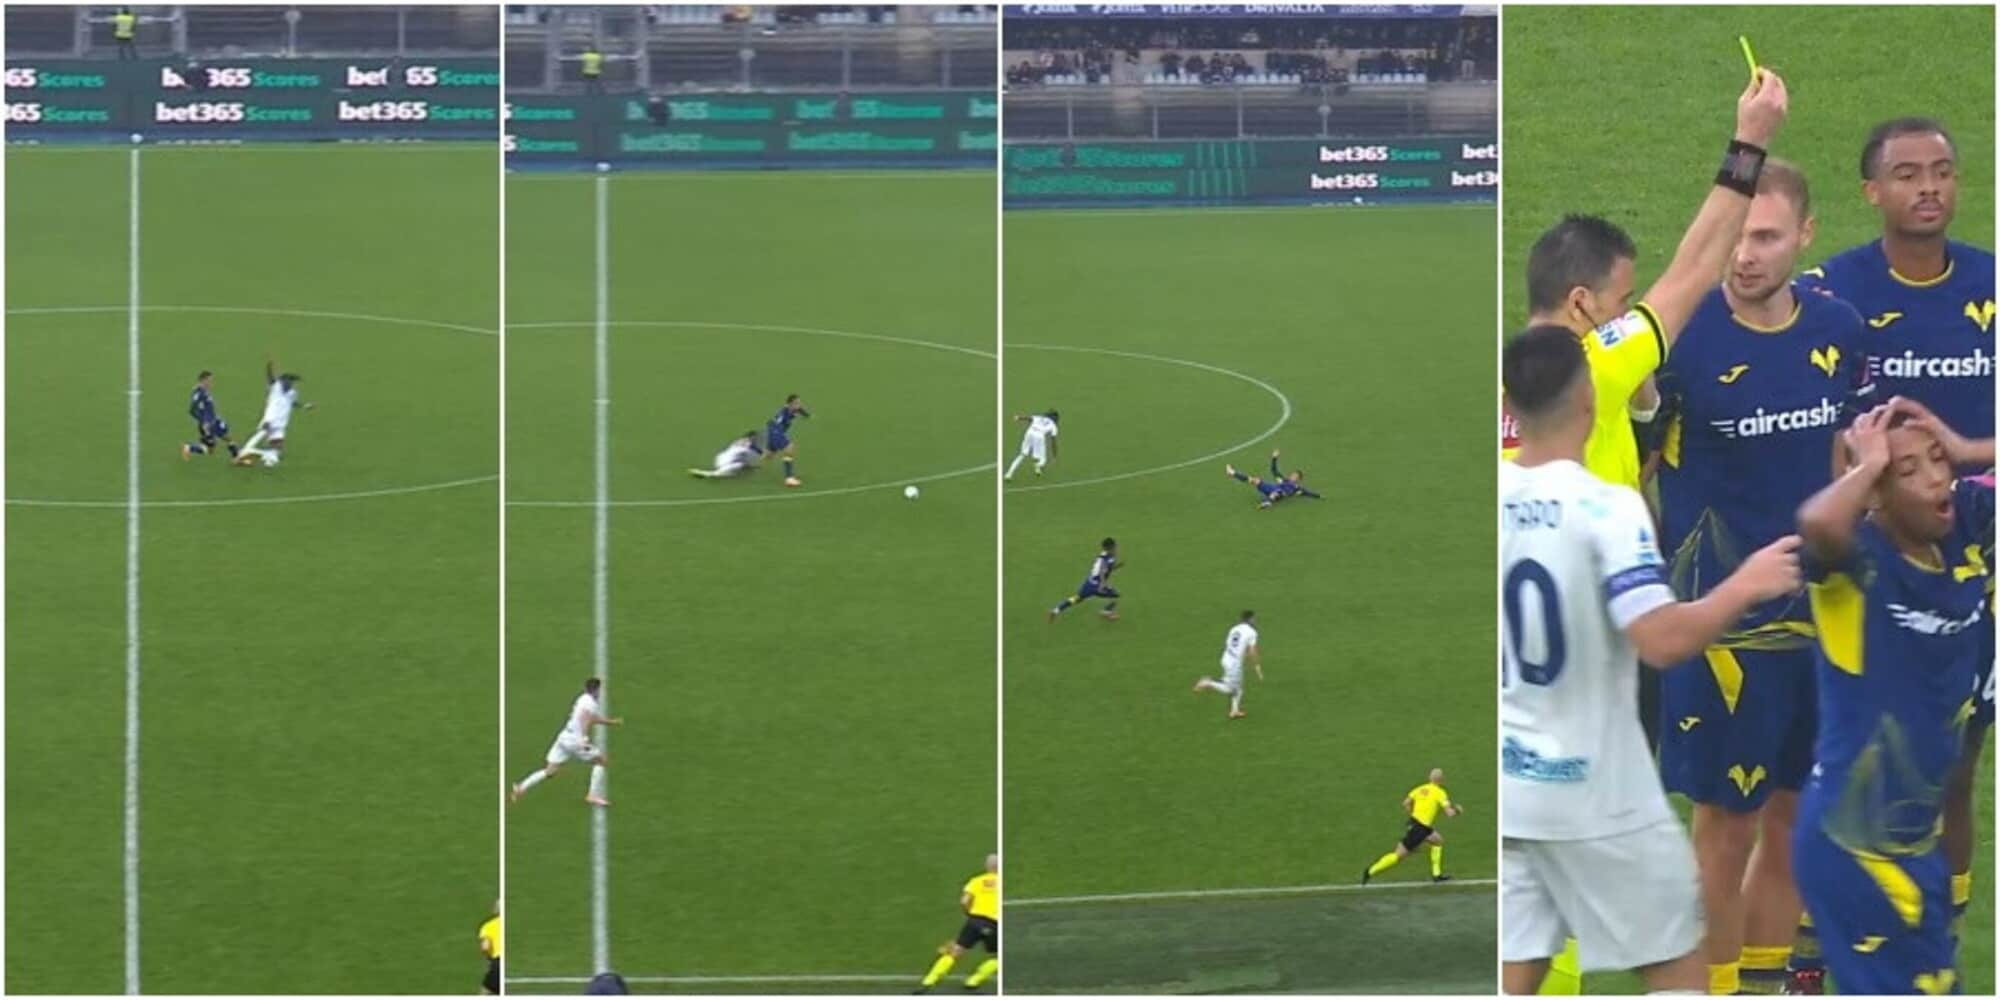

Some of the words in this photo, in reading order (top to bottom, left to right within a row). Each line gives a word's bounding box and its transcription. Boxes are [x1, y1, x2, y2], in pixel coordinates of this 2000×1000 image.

[156, 102, 245, 121] bet365
[246, 106, 312, 121] Scores
[339, 101, 428, 120] bet365
[430, 105, 496, 119] Scores
[1319, 146, 1388, 161] bet365
[1461, 143, 1497, 160] bet
[1311, 173, 1379, 189] bet365
[1451, 170, 1497, 186] bet3
[1882, 349, 1991, 378] aircash
[1737, 398, 1837, 437] aircash
